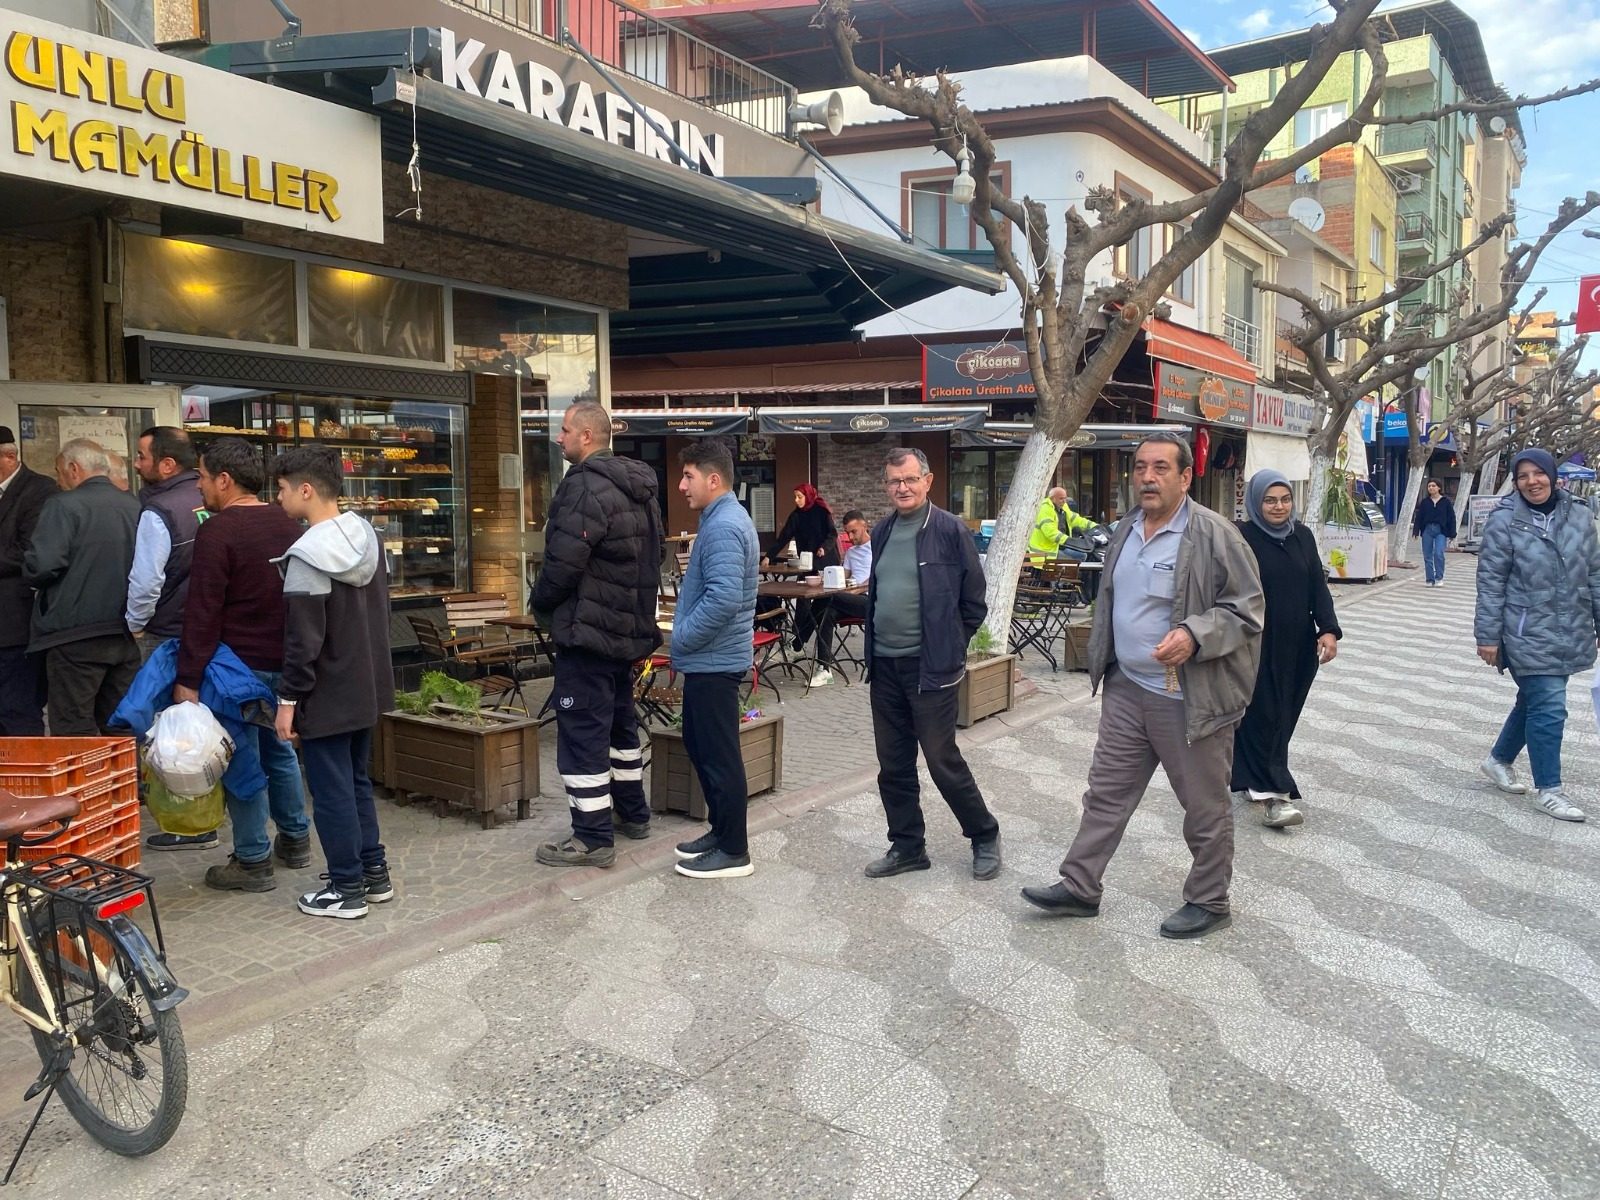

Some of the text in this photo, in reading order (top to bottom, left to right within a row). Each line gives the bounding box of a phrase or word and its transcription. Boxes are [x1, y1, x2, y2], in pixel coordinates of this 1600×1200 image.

[10, 100, 342, 222] MAMÜLLER
[967, 353, 1021, 374] çikoana
[929, 383, 1036, 399] Çikolata Üretim Atö
[1256, 393, 1284, 428] YAVUZ
